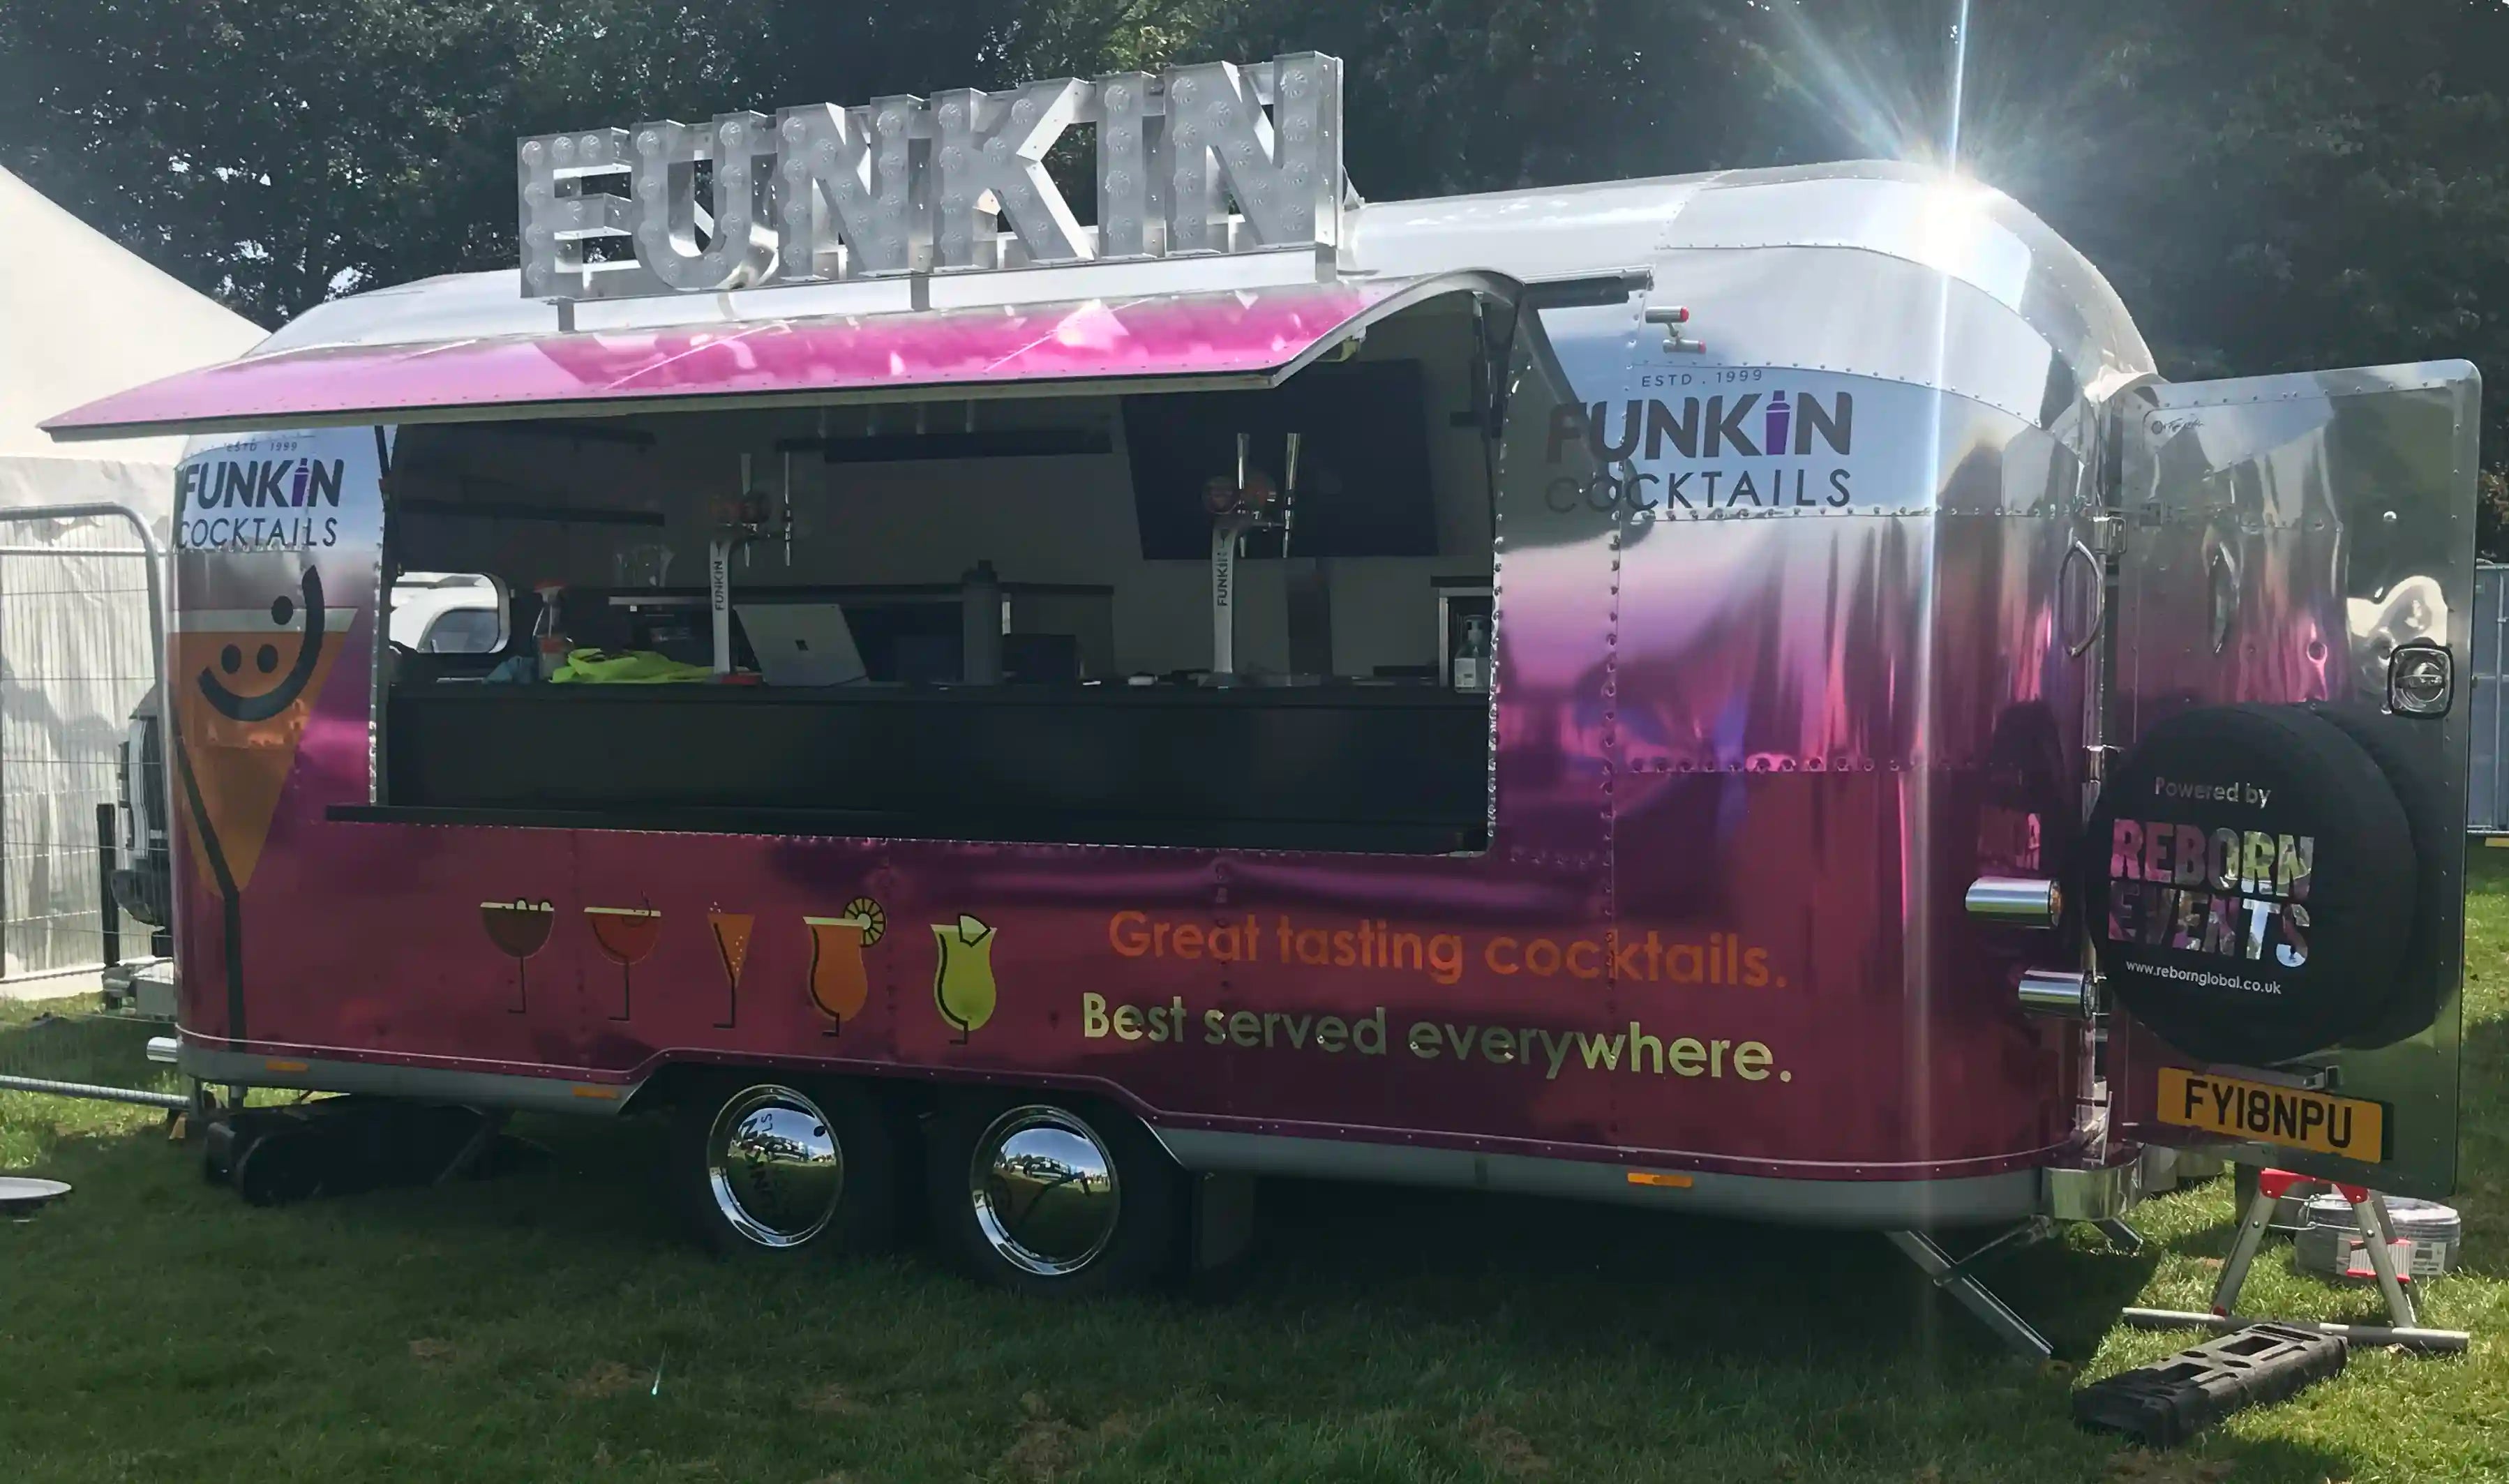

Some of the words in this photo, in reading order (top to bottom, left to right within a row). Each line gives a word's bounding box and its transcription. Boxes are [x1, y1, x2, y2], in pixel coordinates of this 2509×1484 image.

[518, 51, 1340, 299] FUNKIN
[1642, 373, 1693, 387] ESTD
[1716, 369, 1762, 384] 1999
[270, 442, 298, 451] 1999
[1545, 468, 1851, 513] COCKTAILS
[177, 517, 338, 548] COCKTAILS
[2155, 777, 2238, 803] Powered
[2246, 781, 2271, 809] by
[2110, 818, 2315, 897] REBORN
[1109, 910, 1260, 961] Great
[1276, 915, 1462, 985] tasting
[1484, 929, 1788, 988] cocktails.
[2108, 880, 2311, 968] EVENTS
[2126, 959, 2282, 995] www.rebornglobal.co.uk
[1083, 991, 1187, 1042] Best
[1204, 1006, 1386, 1056] served
[1407, 1021, 1792, 1083] everywhere.
[2184, 1078, 2352, 1148] FY18NPU
